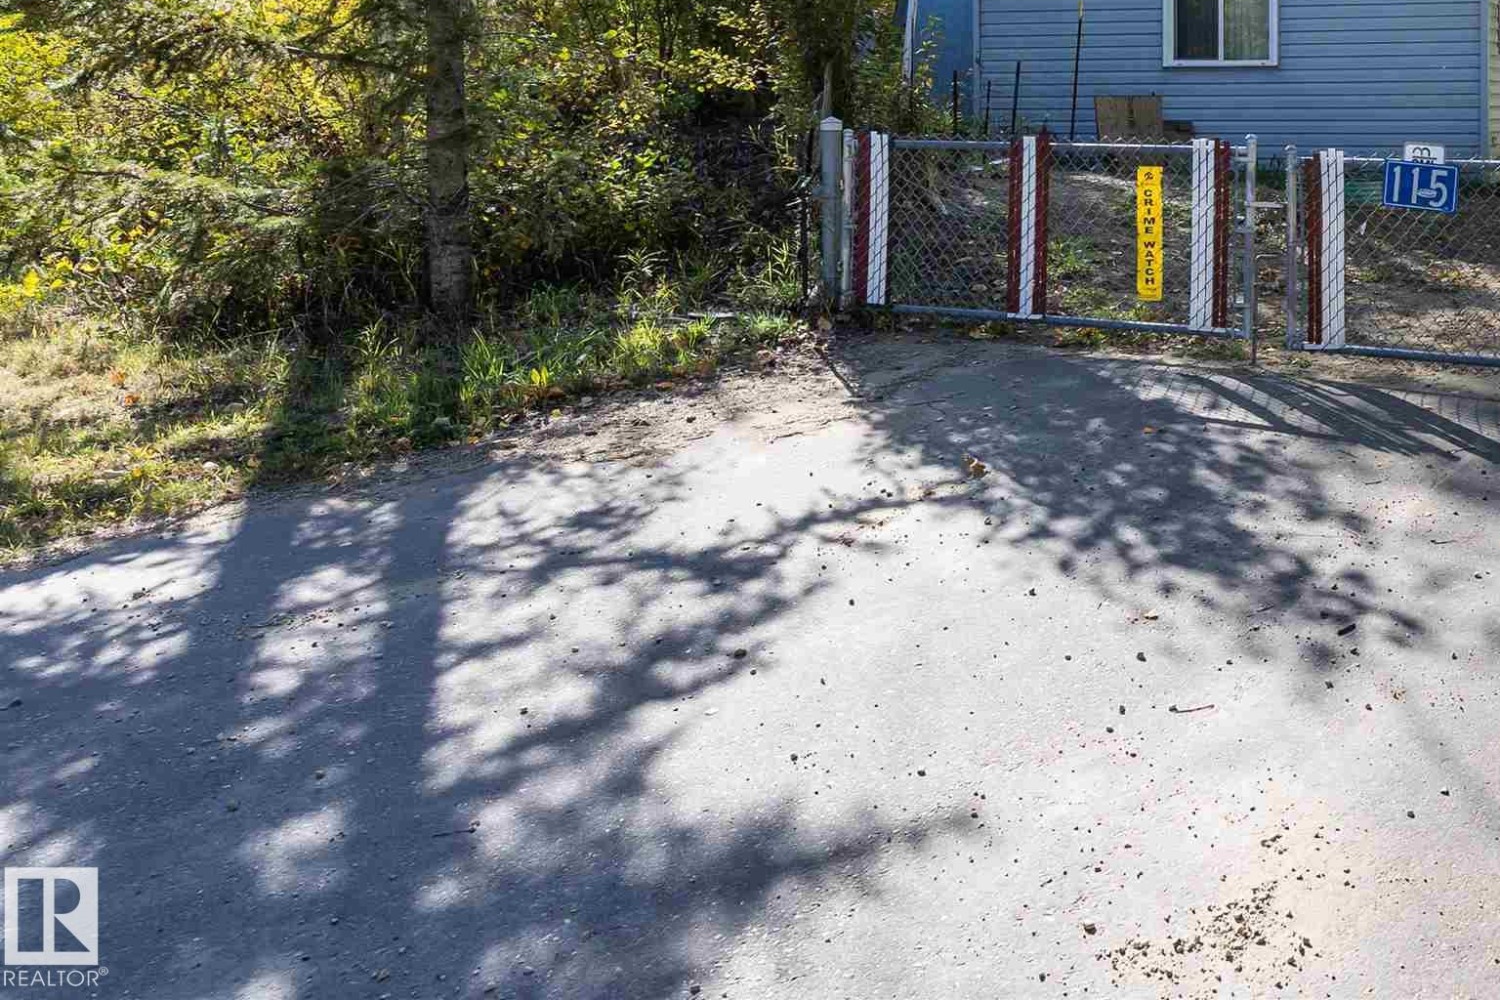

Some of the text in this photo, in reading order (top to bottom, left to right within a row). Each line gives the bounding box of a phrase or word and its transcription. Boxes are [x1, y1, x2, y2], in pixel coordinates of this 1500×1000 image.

[1392, 165, 1449, 208] 115
[1143, 189, 1156, 235] CRIME
[1143, 241, 1156, 286] WATCH
